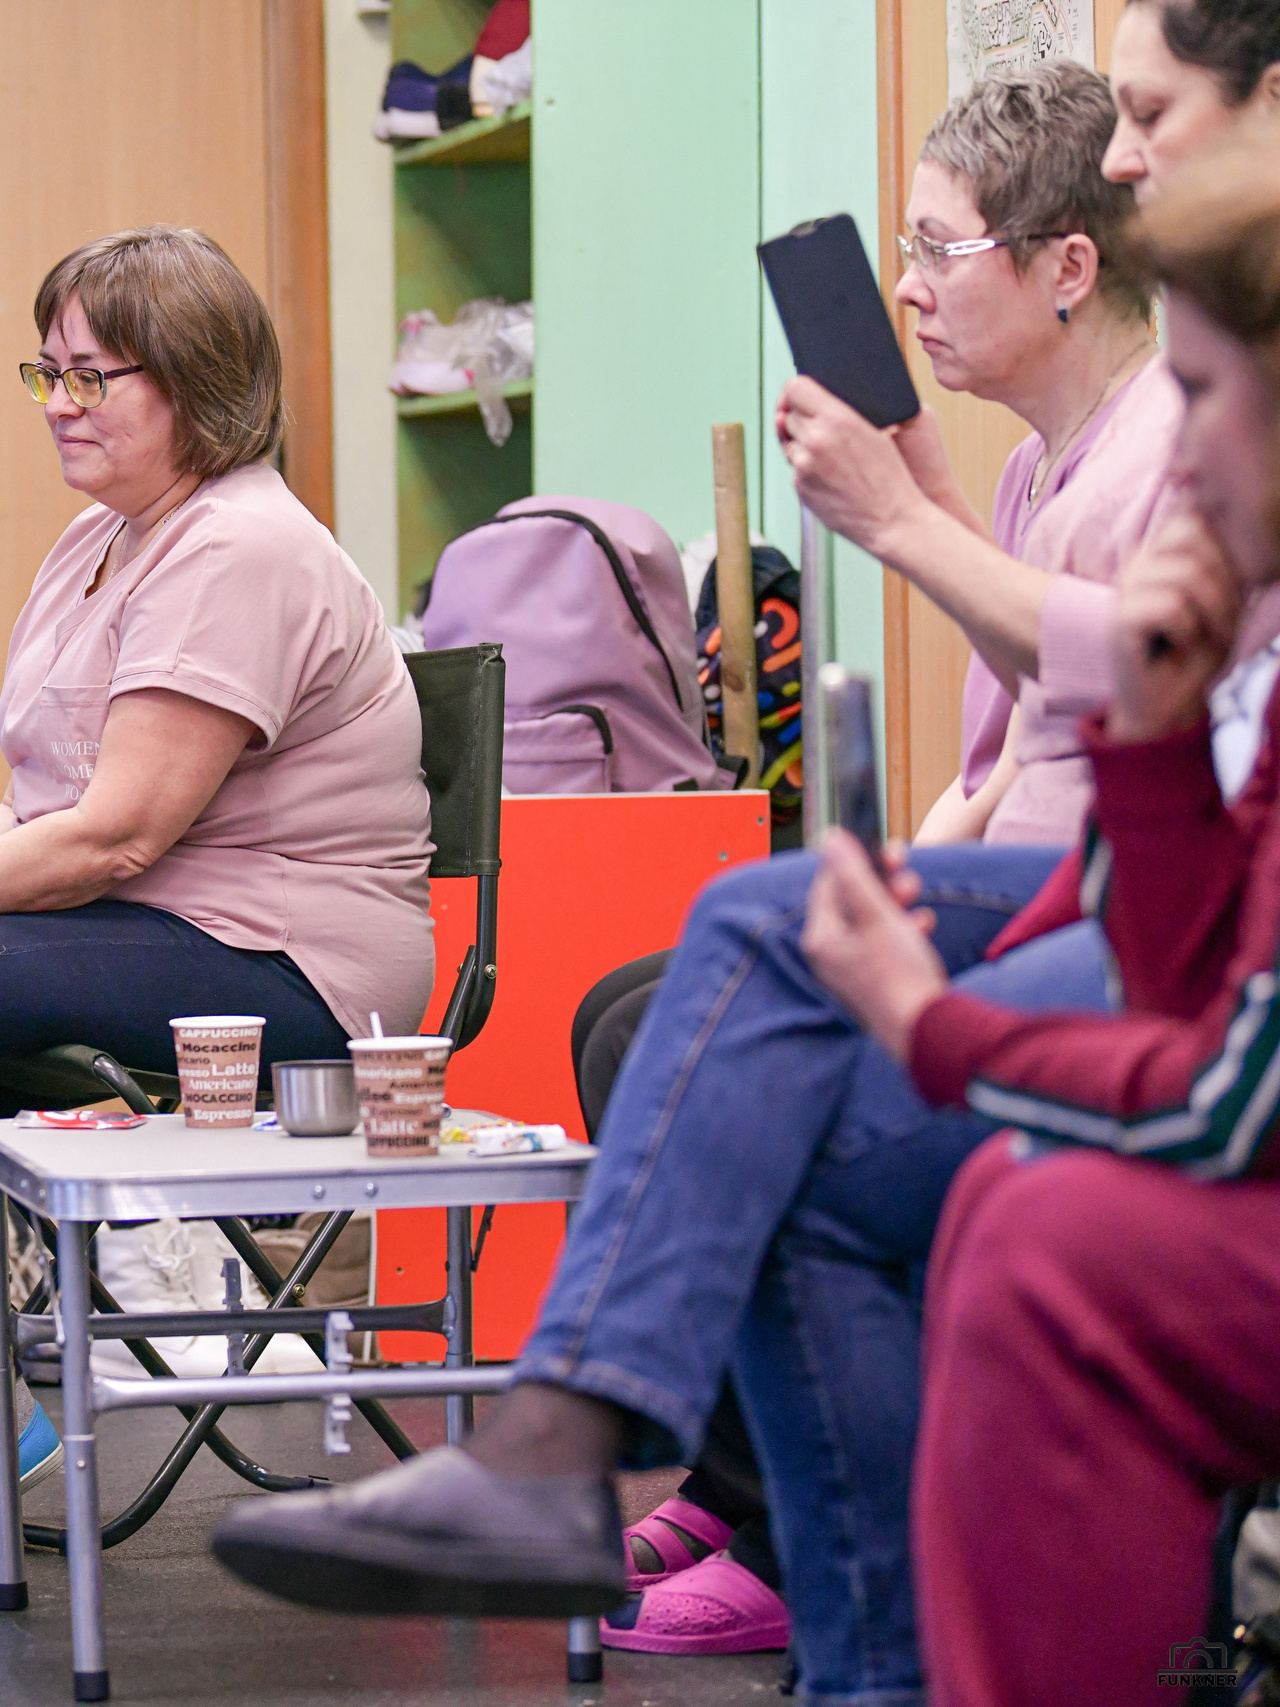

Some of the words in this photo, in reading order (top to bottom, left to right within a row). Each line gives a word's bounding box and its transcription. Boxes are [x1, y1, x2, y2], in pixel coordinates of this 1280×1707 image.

[179, 1027, 258, 1038] CAPPUCCINO
[183, 1042, 257, 1052] Mocaccino
[211, 1063, 256, 1076] Latte
[189, 1078, 255, 1090] Americano
[185, 1093, 252, 1103] MOCACCINO
[193, 1109, 252, 1123] Espresso
